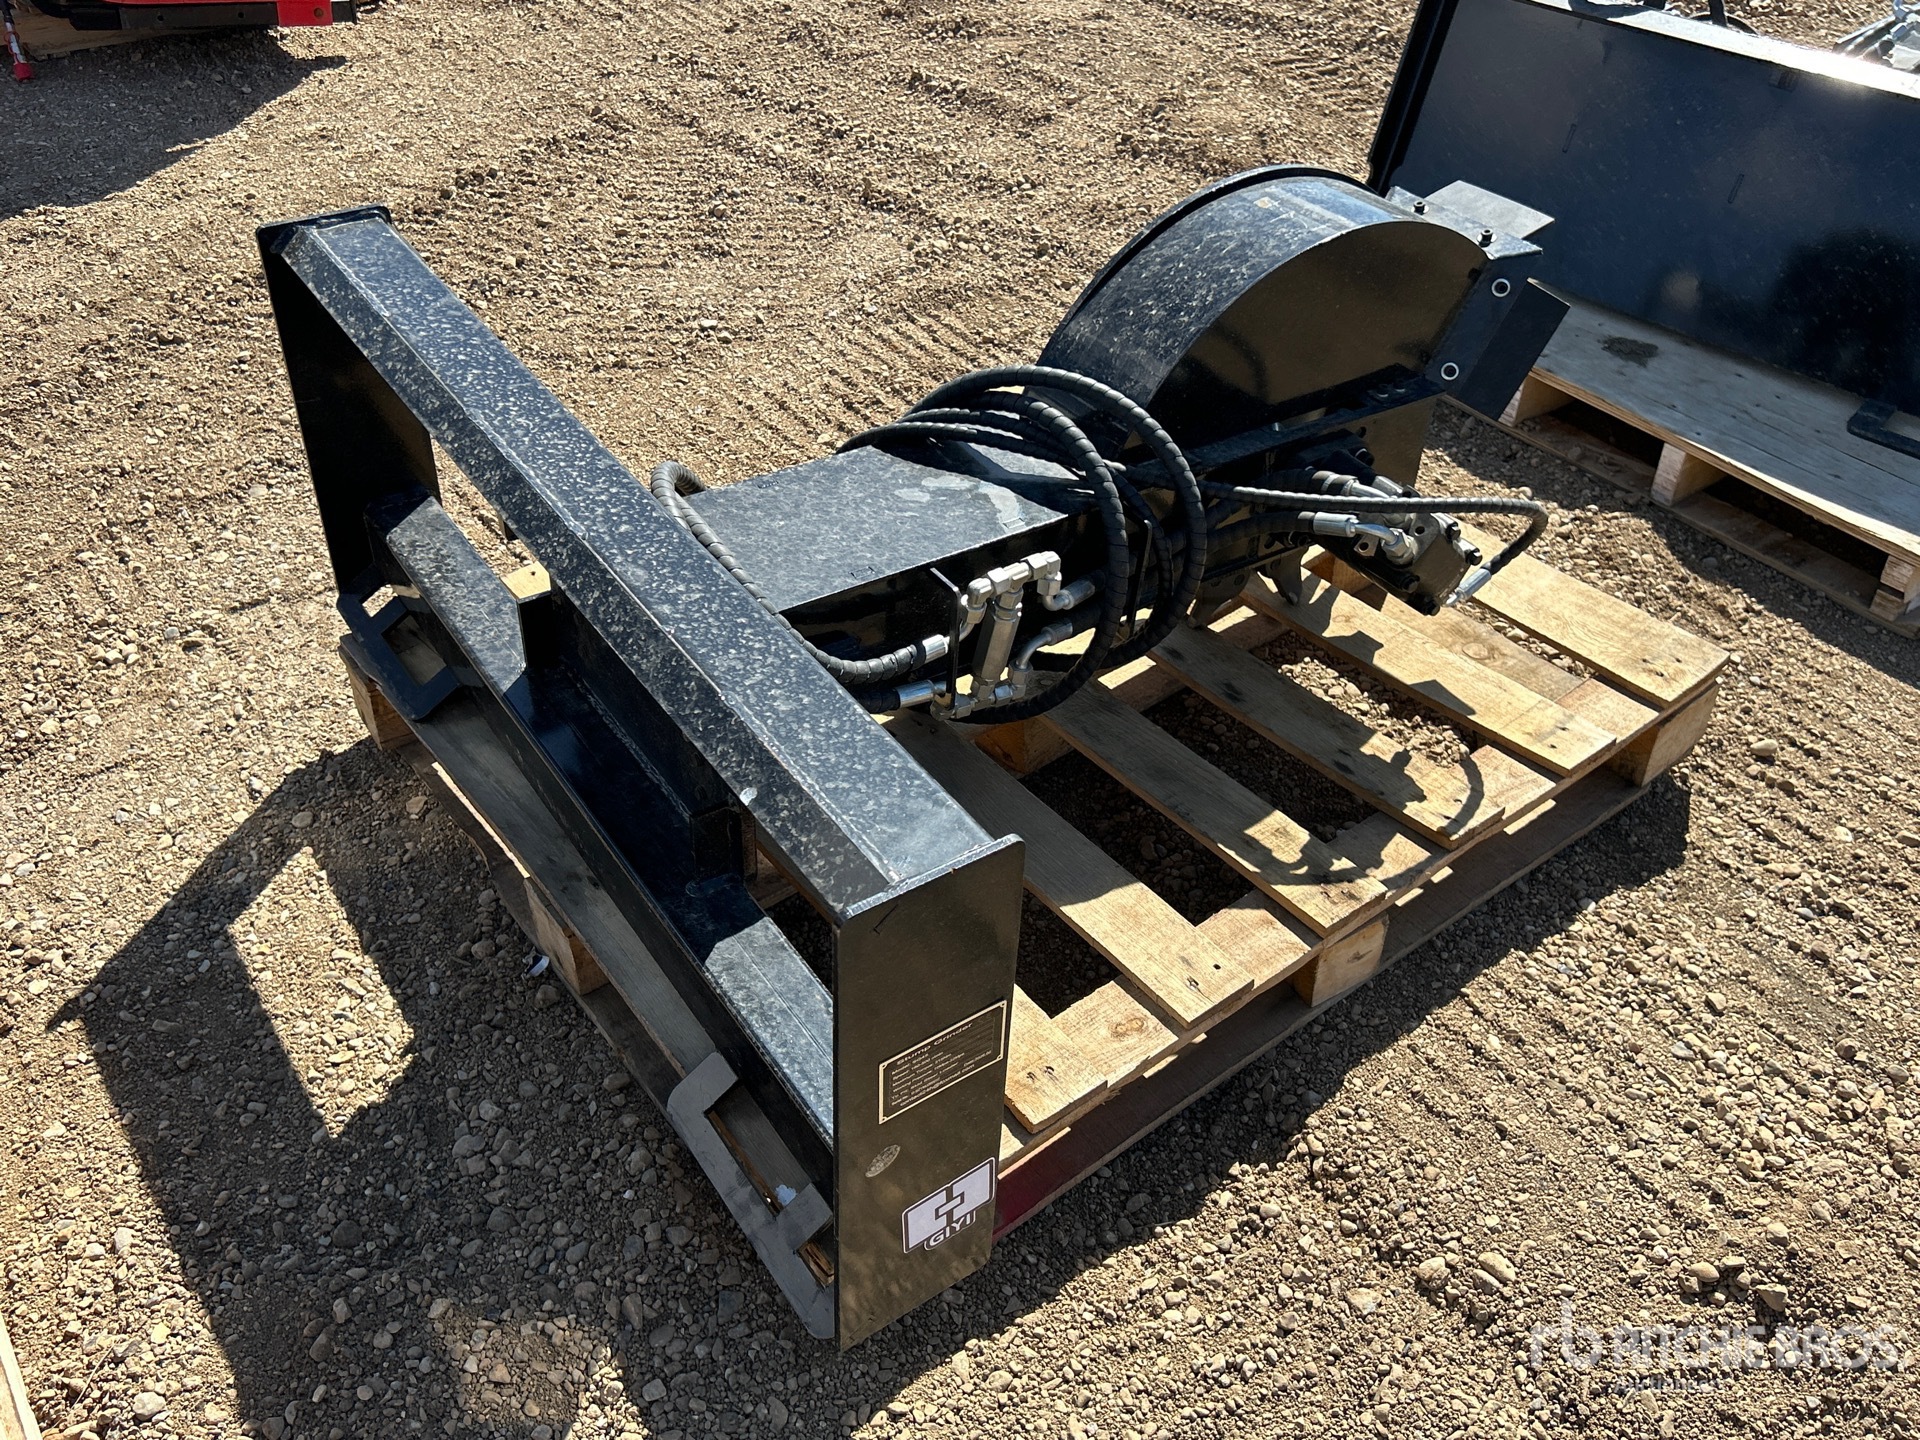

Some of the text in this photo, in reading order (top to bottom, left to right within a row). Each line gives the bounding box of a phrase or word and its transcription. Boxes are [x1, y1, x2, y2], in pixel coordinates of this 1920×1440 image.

[896, 1046, 931, 1066] Stump
[934, 1023, 973, 1046] Grinder
[929, 1213, 971, 1246] GIYI
